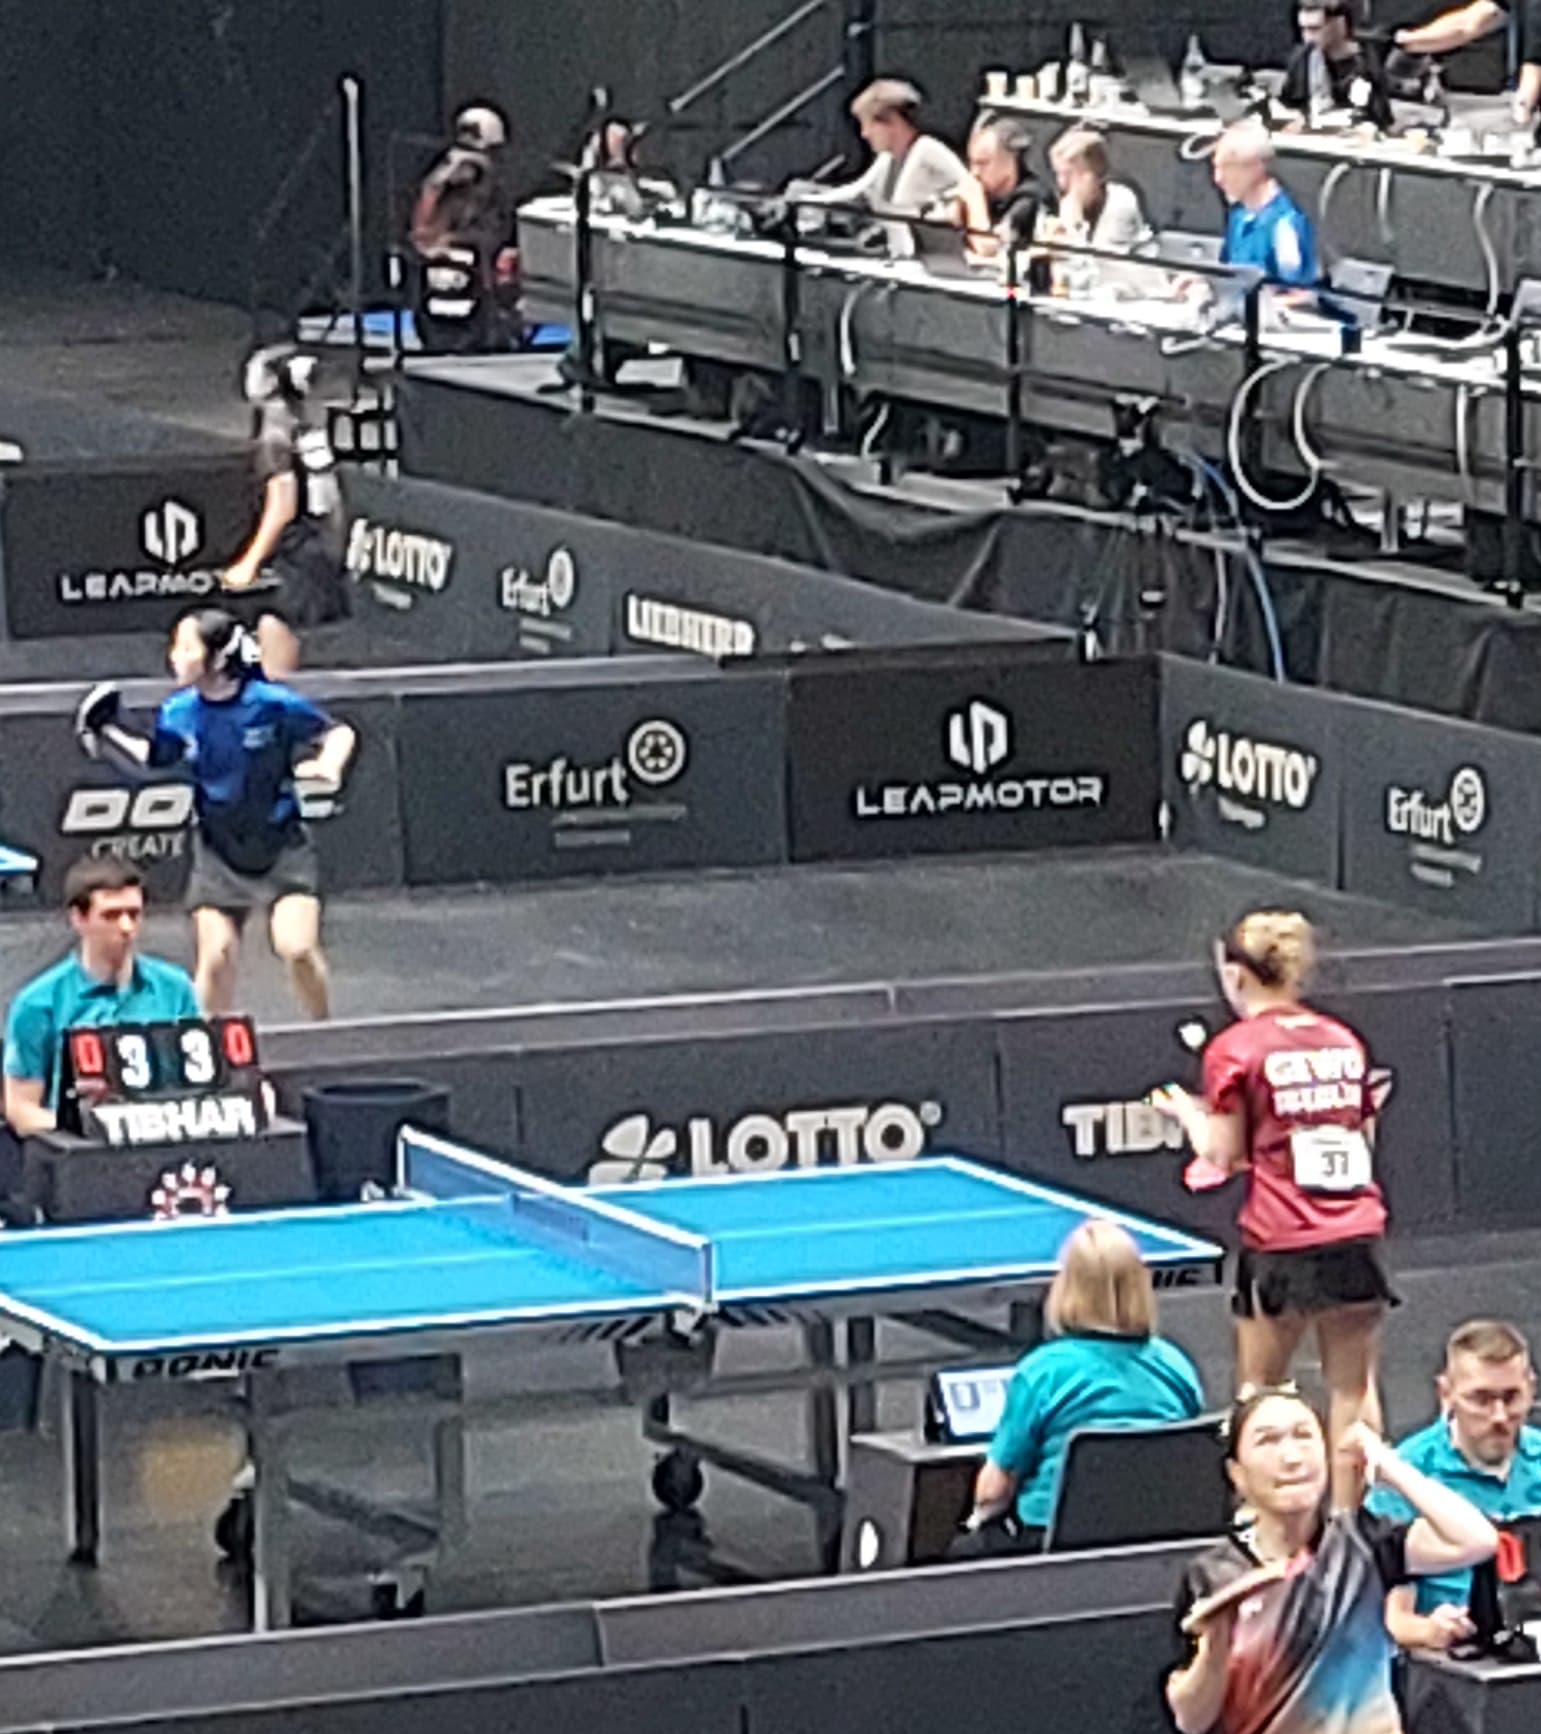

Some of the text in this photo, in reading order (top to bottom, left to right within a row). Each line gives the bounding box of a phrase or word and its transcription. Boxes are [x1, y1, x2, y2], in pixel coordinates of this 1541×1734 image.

[506, 756, 629, 807] Erfurt
[857, 776, 1102, 816] LEAPMOTOR
[1389, 786, 1454, 844] Erfurt
[117, 1035, 151, 1088] 3
[181, 1029, 214, 1083] 3
[92, 1096, 255, 1145] TIBHAR
[1062, 1101, 1183, 1155] TIB
[132, 1348, 279, 1379] DONIC
